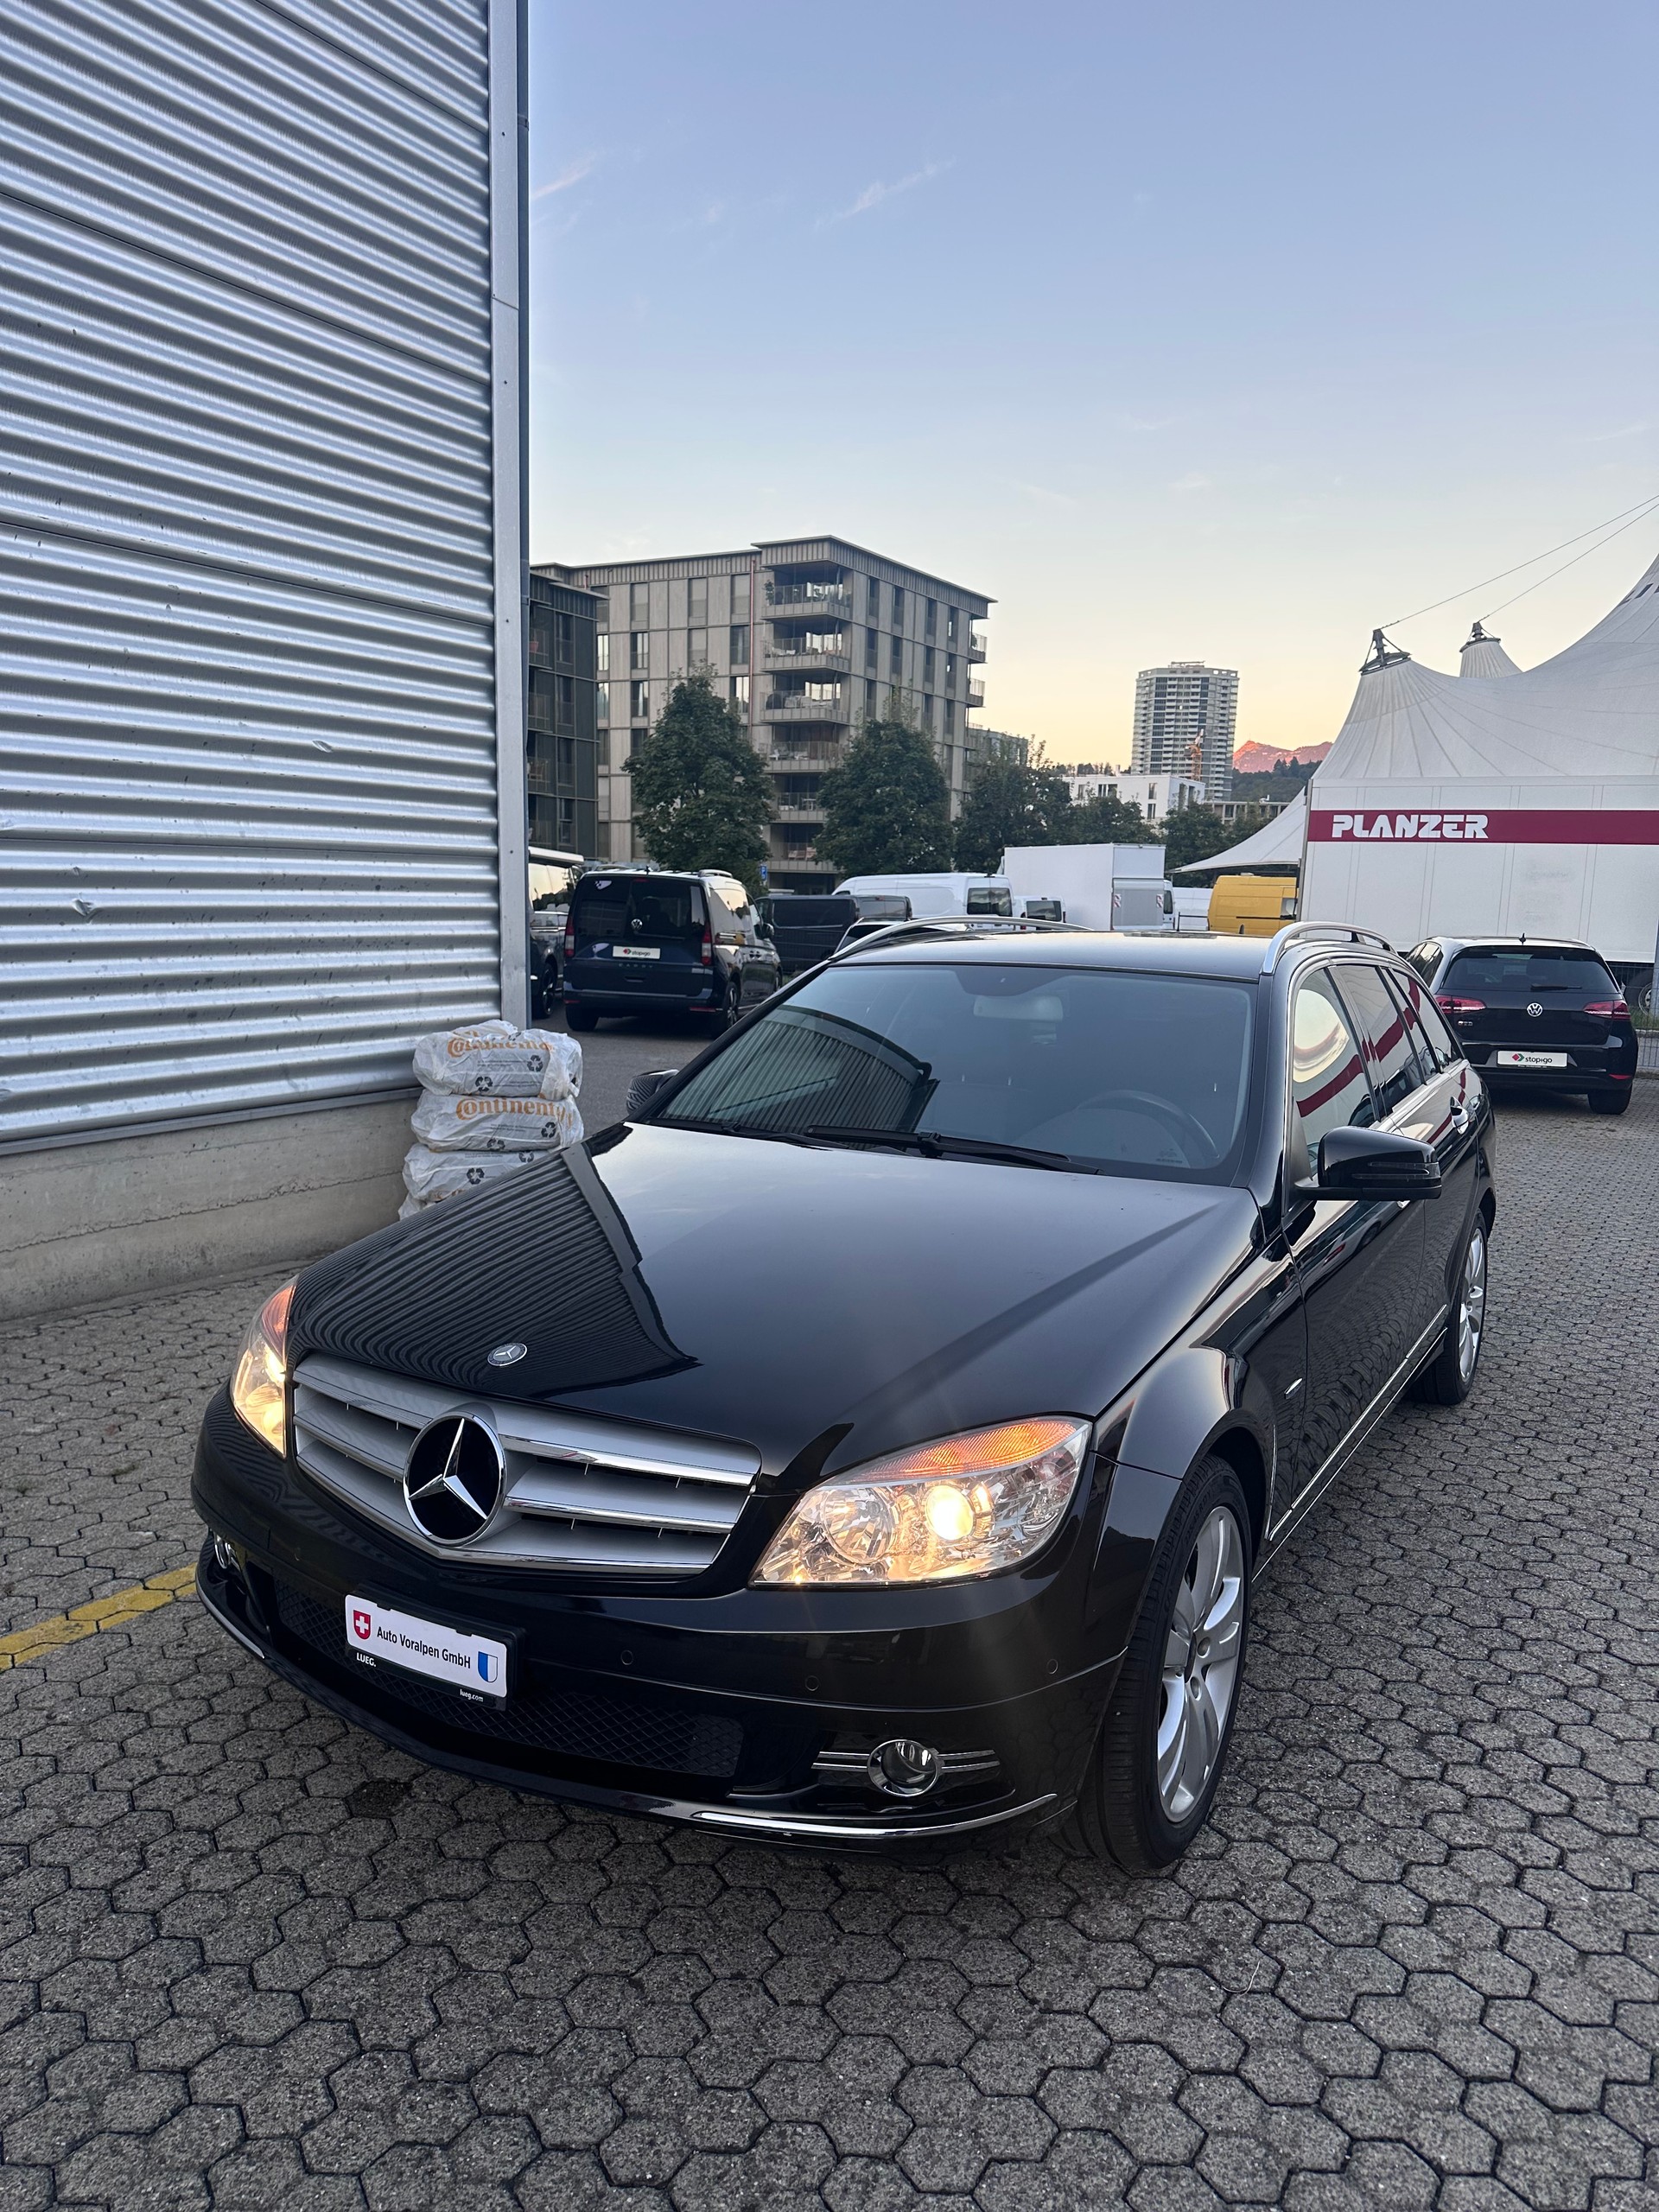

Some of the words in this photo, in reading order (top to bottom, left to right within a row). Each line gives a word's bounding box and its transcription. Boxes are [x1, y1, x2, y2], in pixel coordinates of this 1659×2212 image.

[1332, 814, 1489, 839] PLANZER
[377, 1626, 397, 1644] Auto
[400, 1633, 440, 1658] Voralpen
[442, 1649, 471, 1669] GmbH
[356, 1652, 377, 1668] LUEG.
[460, 1688, 484, 1703] lueg.com
